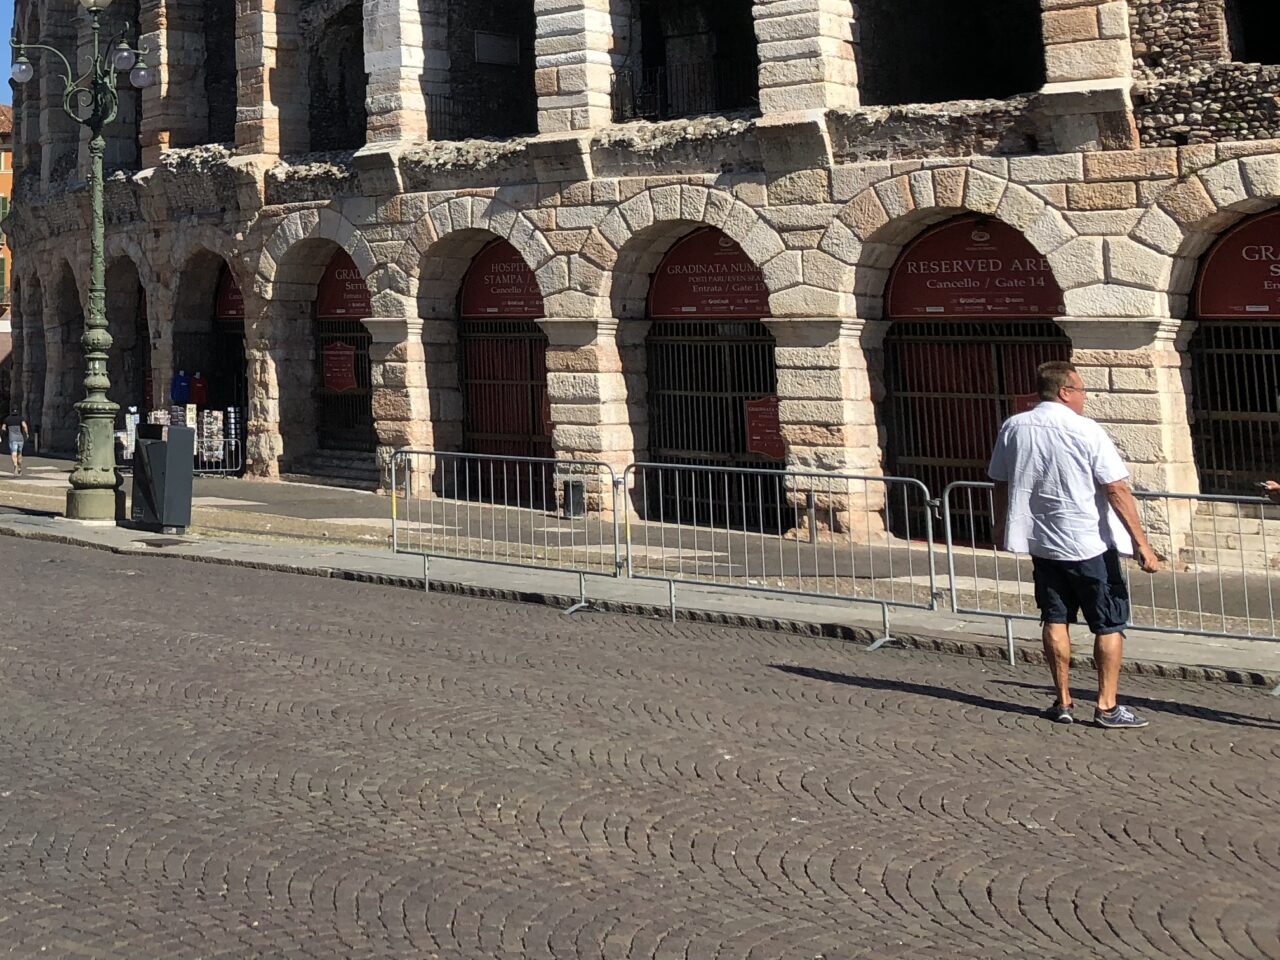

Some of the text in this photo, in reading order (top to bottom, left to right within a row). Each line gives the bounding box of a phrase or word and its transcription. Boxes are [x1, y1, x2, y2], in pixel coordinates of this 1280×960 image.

[1242, 245, 1280, 260] GR
[667, 263, 727, 274] GRADINATA
[907, 258, 1050, 273] RESERVED ARE
[484, 274, 523, 285] STAMPA
[926, 278, 980, 289] Cancello
[995, 277, 1026, 288] Gate
[1029, 276, 1045, 287] 14
[490, 286, 521, 294] Cancello
[692, 284, 722, 293] Entrata
[732, 283, 753, 292] Gate
